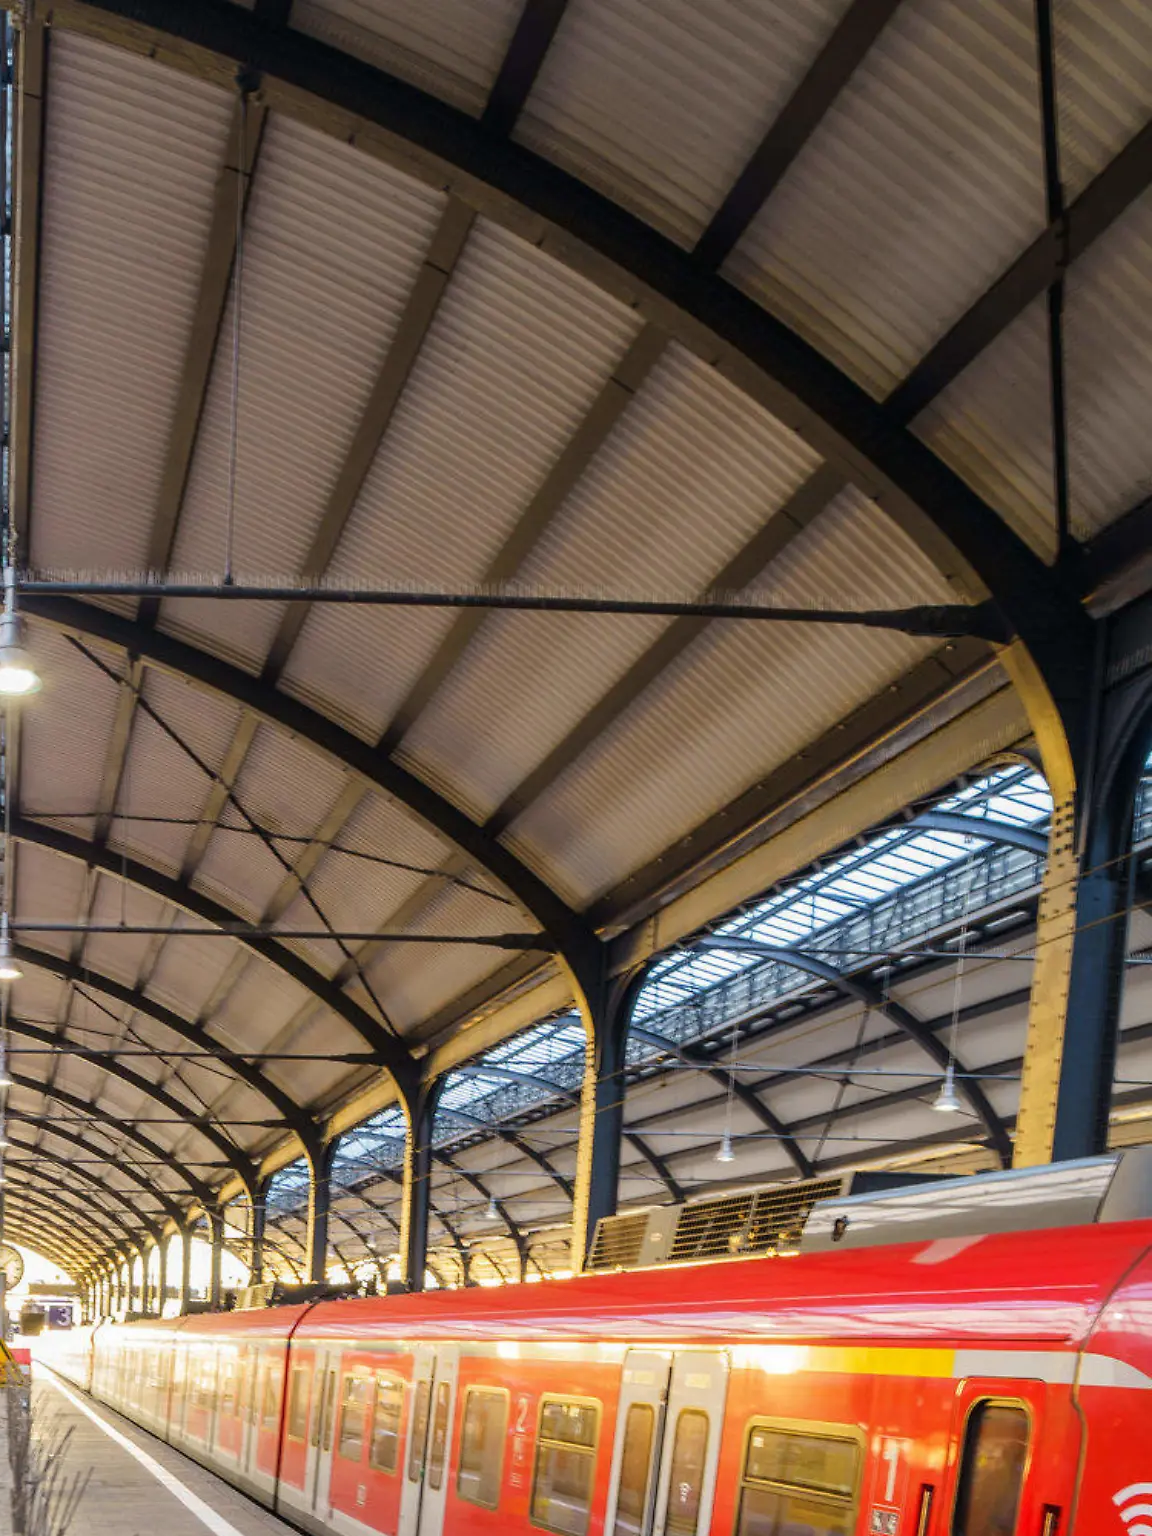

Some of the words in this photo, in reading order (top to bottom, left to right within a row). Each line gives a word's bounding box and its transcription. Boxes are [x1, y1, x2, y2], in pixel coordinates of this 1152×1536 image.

[56, 1306, 72, 1327] 3
[515, 1398, 528, 1432] 2
[882, 1438, 899, 1502] 1
